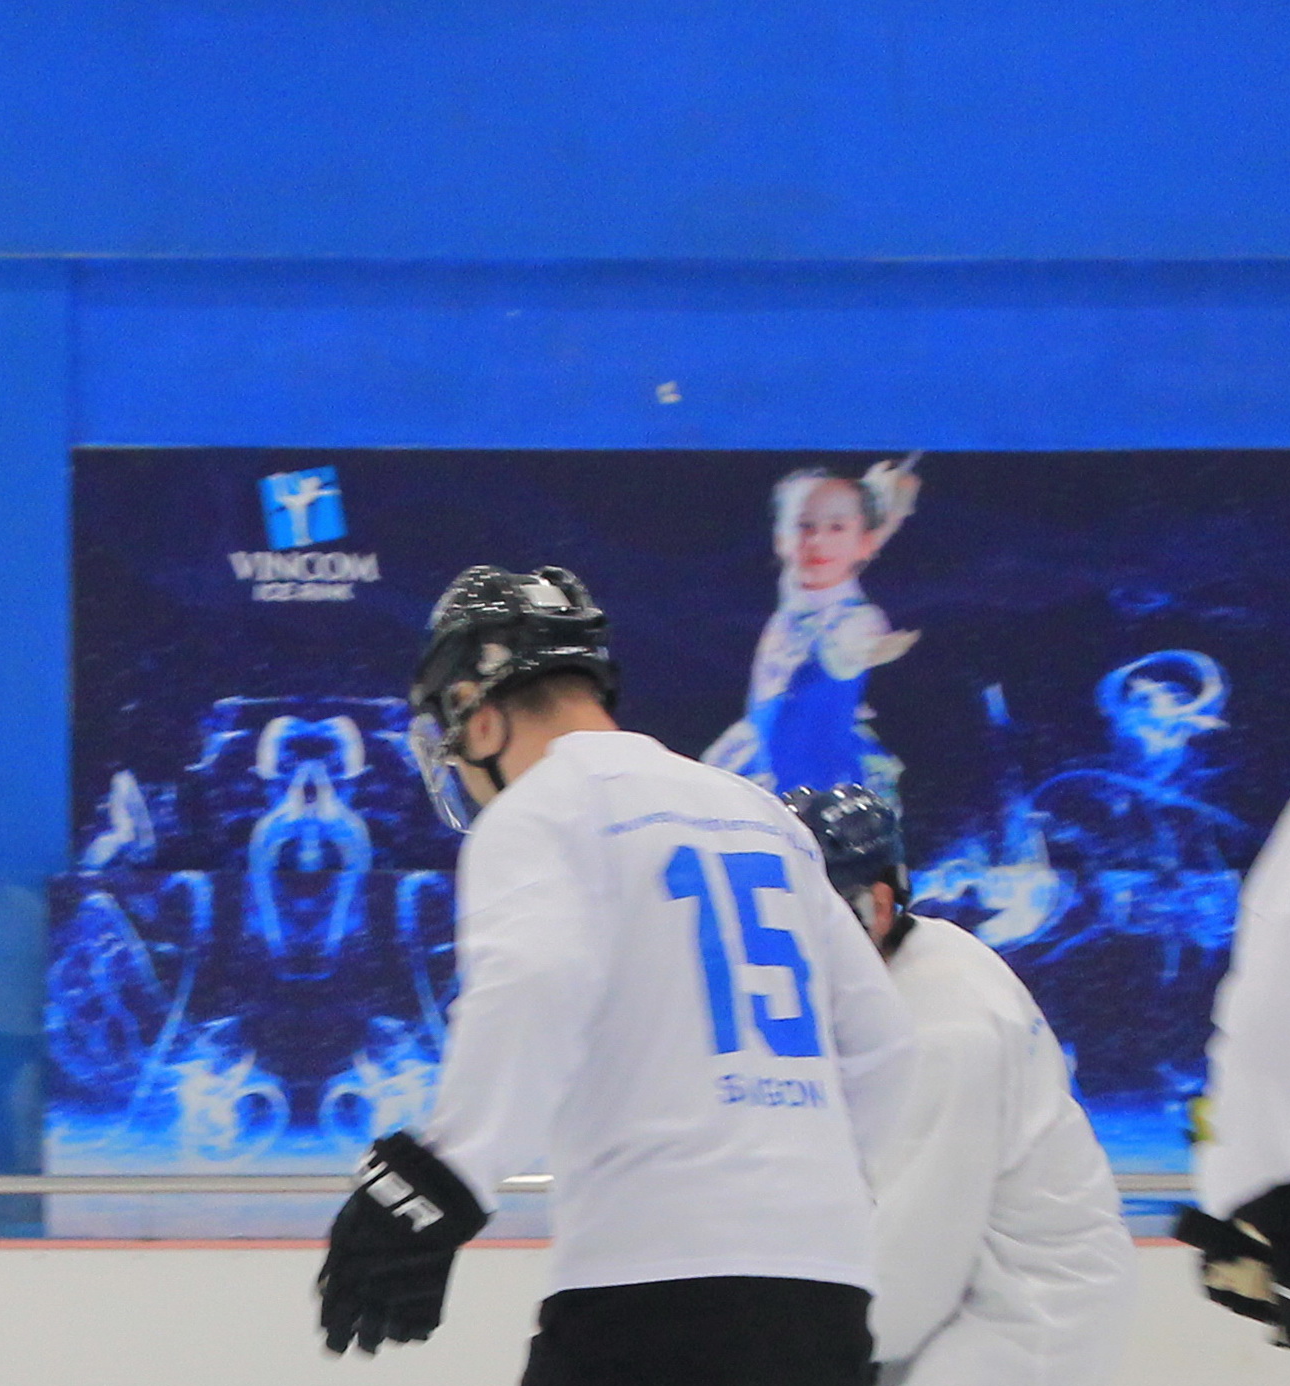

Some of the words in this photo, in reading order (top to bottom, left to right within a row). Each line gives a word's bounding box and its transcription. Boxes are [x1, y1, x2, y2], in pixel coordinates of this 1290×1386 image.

[227, 551, 382, 582] VINCOM
[665, 846, 823, 1058] 15
[716, 1073, 825, 1108] SAIGON
